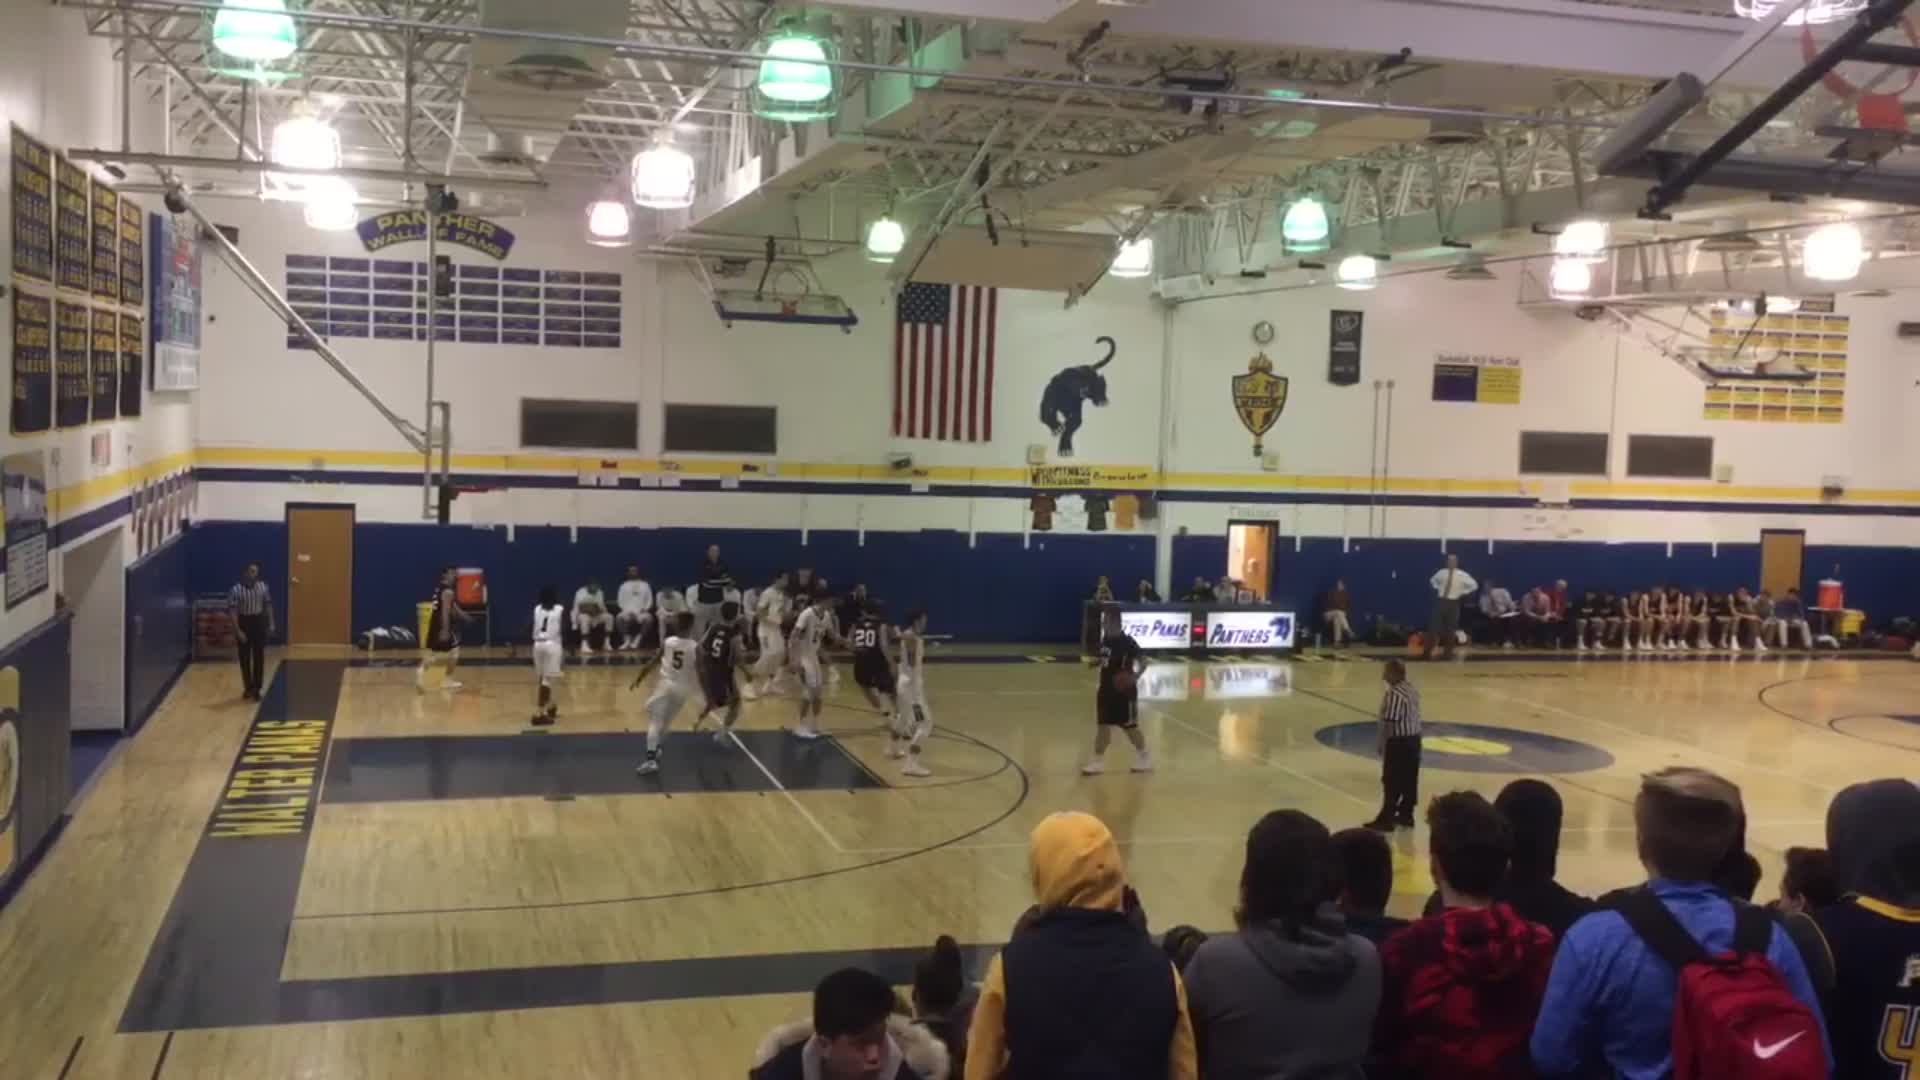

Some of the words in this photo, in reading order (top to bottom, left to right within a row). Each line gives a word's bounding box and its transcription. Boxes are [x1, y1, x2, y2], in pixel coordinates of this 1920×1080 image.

[376, 210, 495, 238] PANHER
[541, 616, 548, 632] 1
[1210, 623, 1272, 645] PANTHERS
[855, 629, 875, 648] 20
[671, 650, 684, 670] 5
[241, 720, 327, 764] PANAS
[208, 766, 317, 837] WALTER
